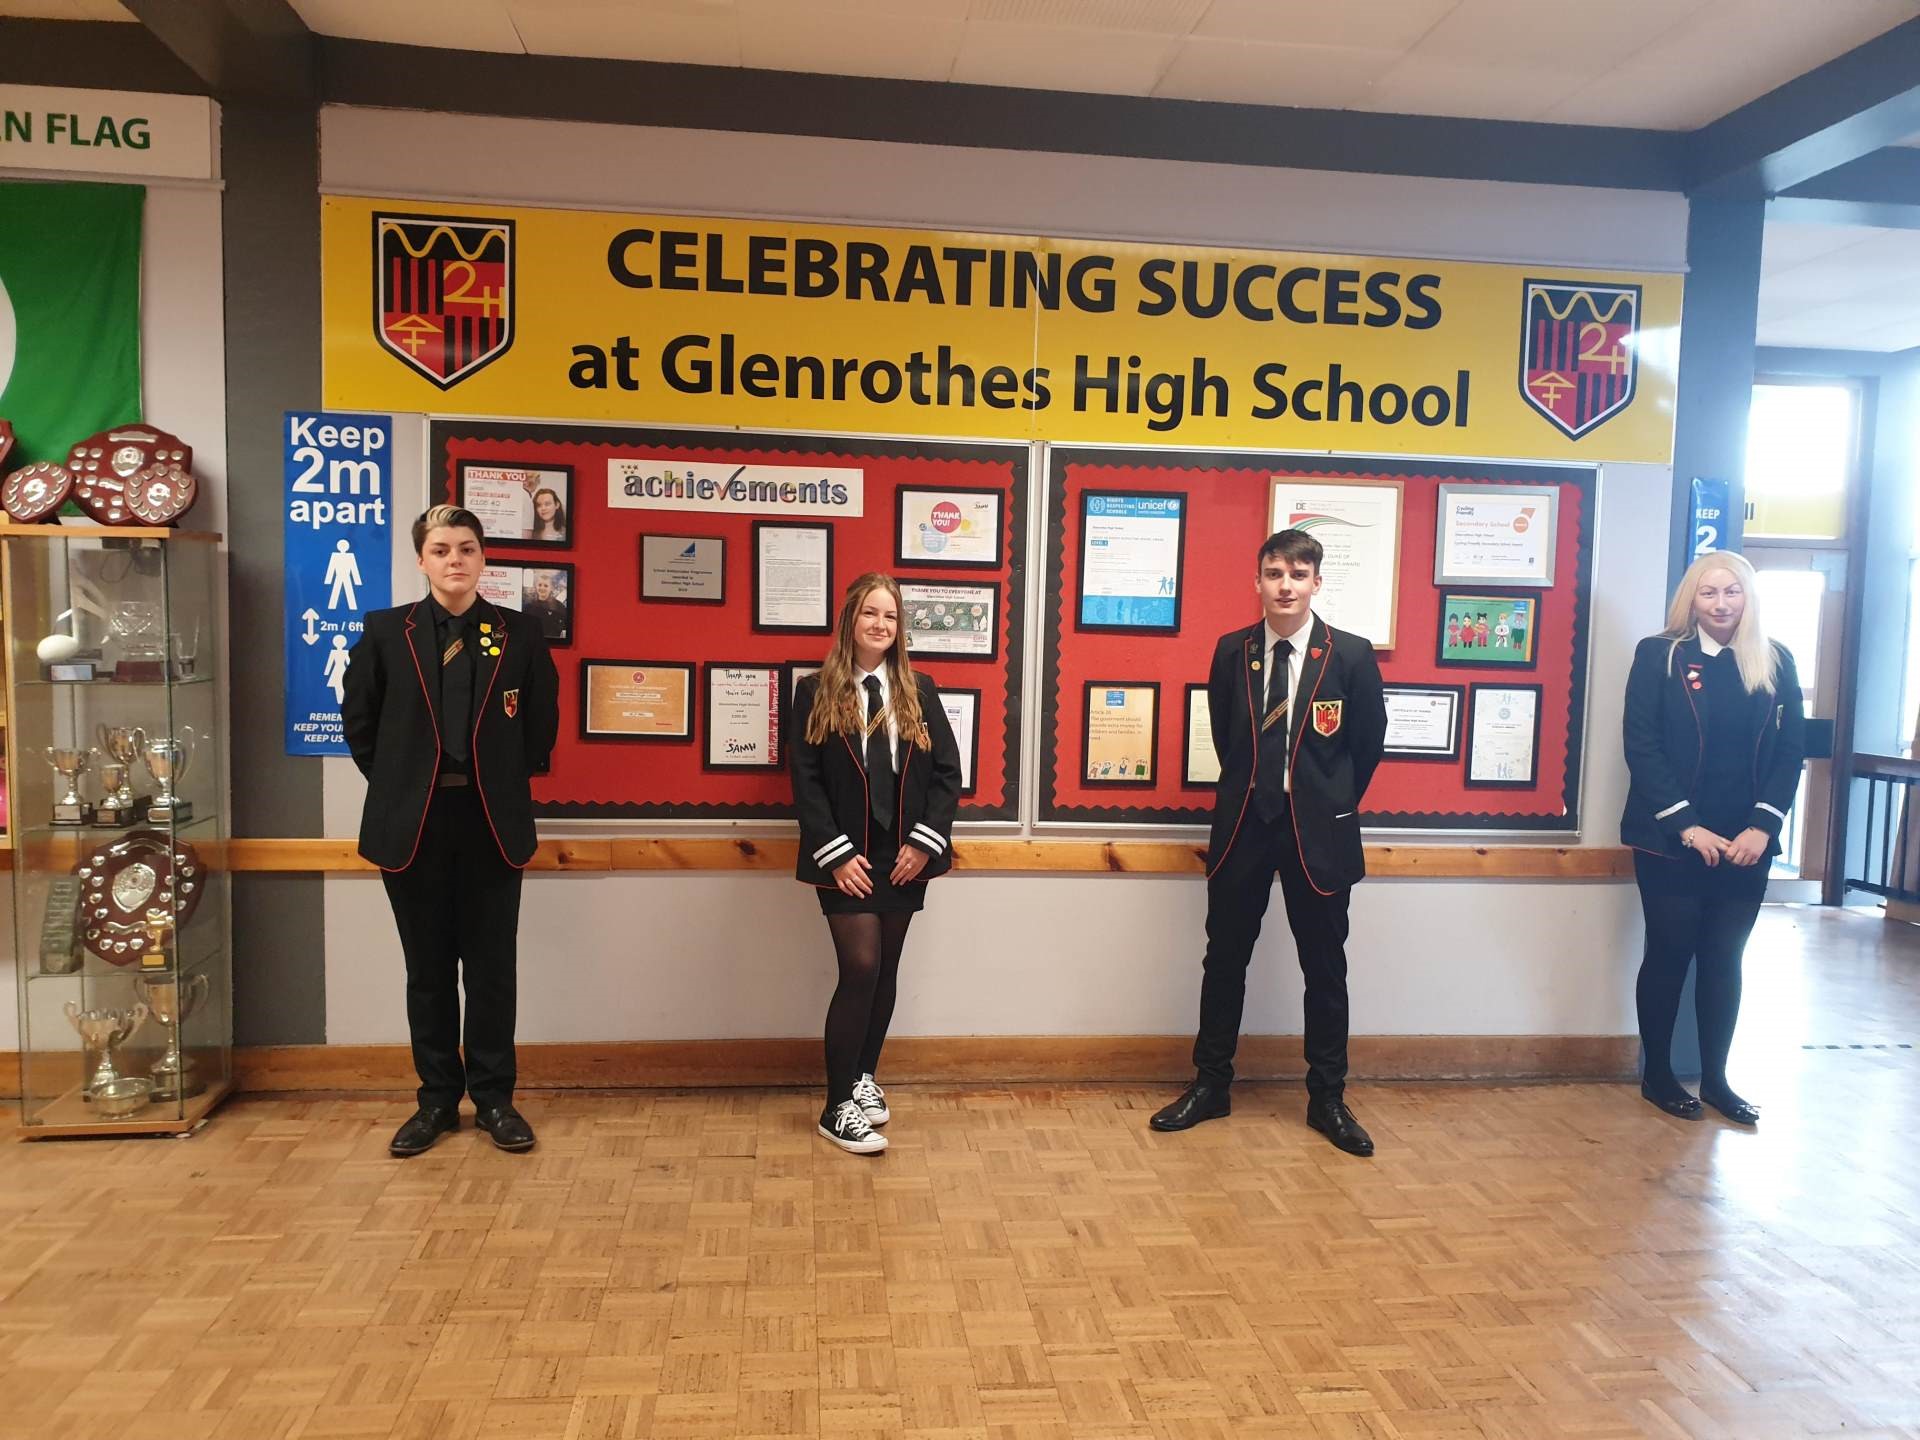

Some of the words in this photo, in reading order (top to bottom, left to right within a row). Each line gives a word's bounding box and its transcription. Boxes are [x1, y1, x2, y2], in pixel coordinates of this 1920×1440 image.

[0, 111, 32, 143] N
[46, 112, 150, 150] FLAG
[607, 228, 1116, 313] CELEBRATING
[1137, 258, 1442, 330] SUCCESS
[568, 335, 640, 391] at
[661, 333, 1052, 411] Glenrothes
[1073, 354, 1229, 432] High
[1250, 362, 1470, 427] School
[290, 416, 385, 456] Keep
[292, 446, 380, 496] 2m
[470, 470, 504, 480] THANK
[506, 473, 527, 481] YOU
[624, 466, 848, 506] achievements
[1138, 500, 1166, 510] unicef
[290, 497, 386, 530] apart
[933, 511, 961, 520] THANK
[1696, 508, 1720, 520] KEEP
[320, 621, 338, 631] 2m
[348, 622, 364, 632] 6ft
[293, 723, 319, 732] KEEP
[320, 724, 344, 732] YOU
[304, 734, 329, 743] KEEP
[726, 742, 756, 754] SAMH
